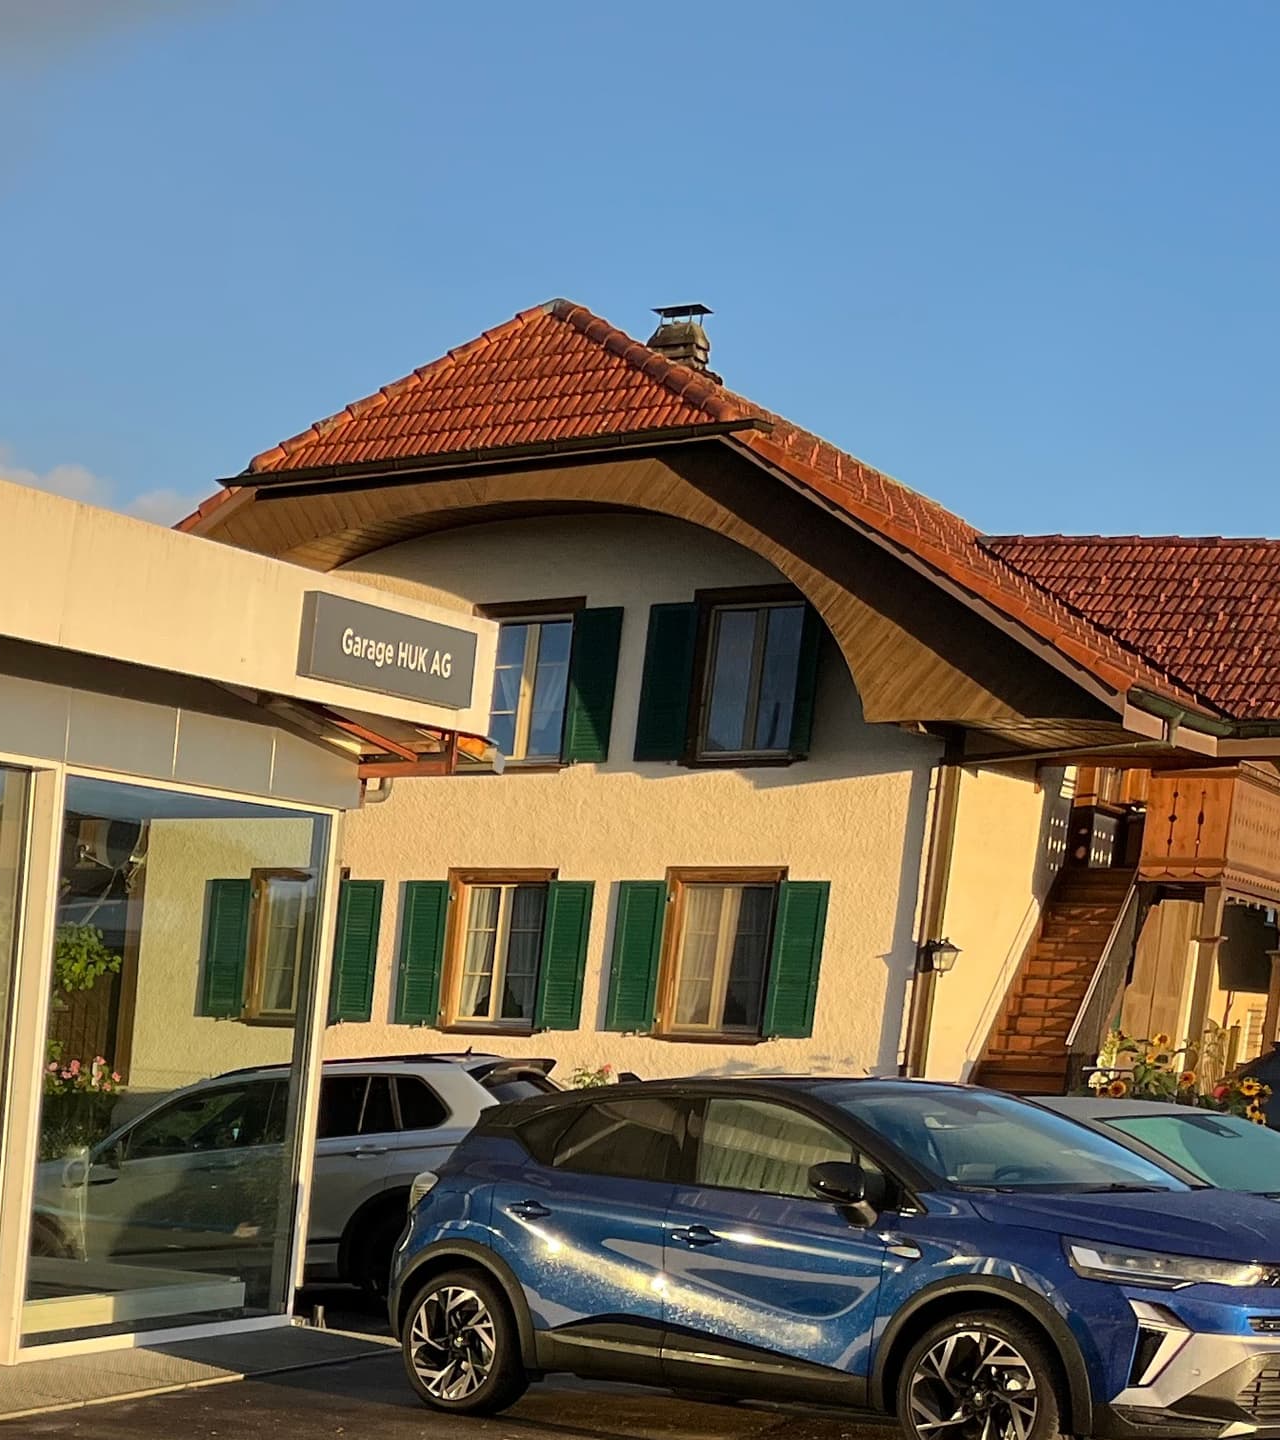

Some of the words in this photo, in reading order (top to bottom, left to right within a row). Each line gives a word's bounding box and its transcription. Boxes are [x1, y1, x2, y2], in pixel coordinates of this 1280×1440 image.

[342, 627, 394, 667] Garage
[397, 642, 429, 672] HUK
[429, 652, 453, 679] AG
